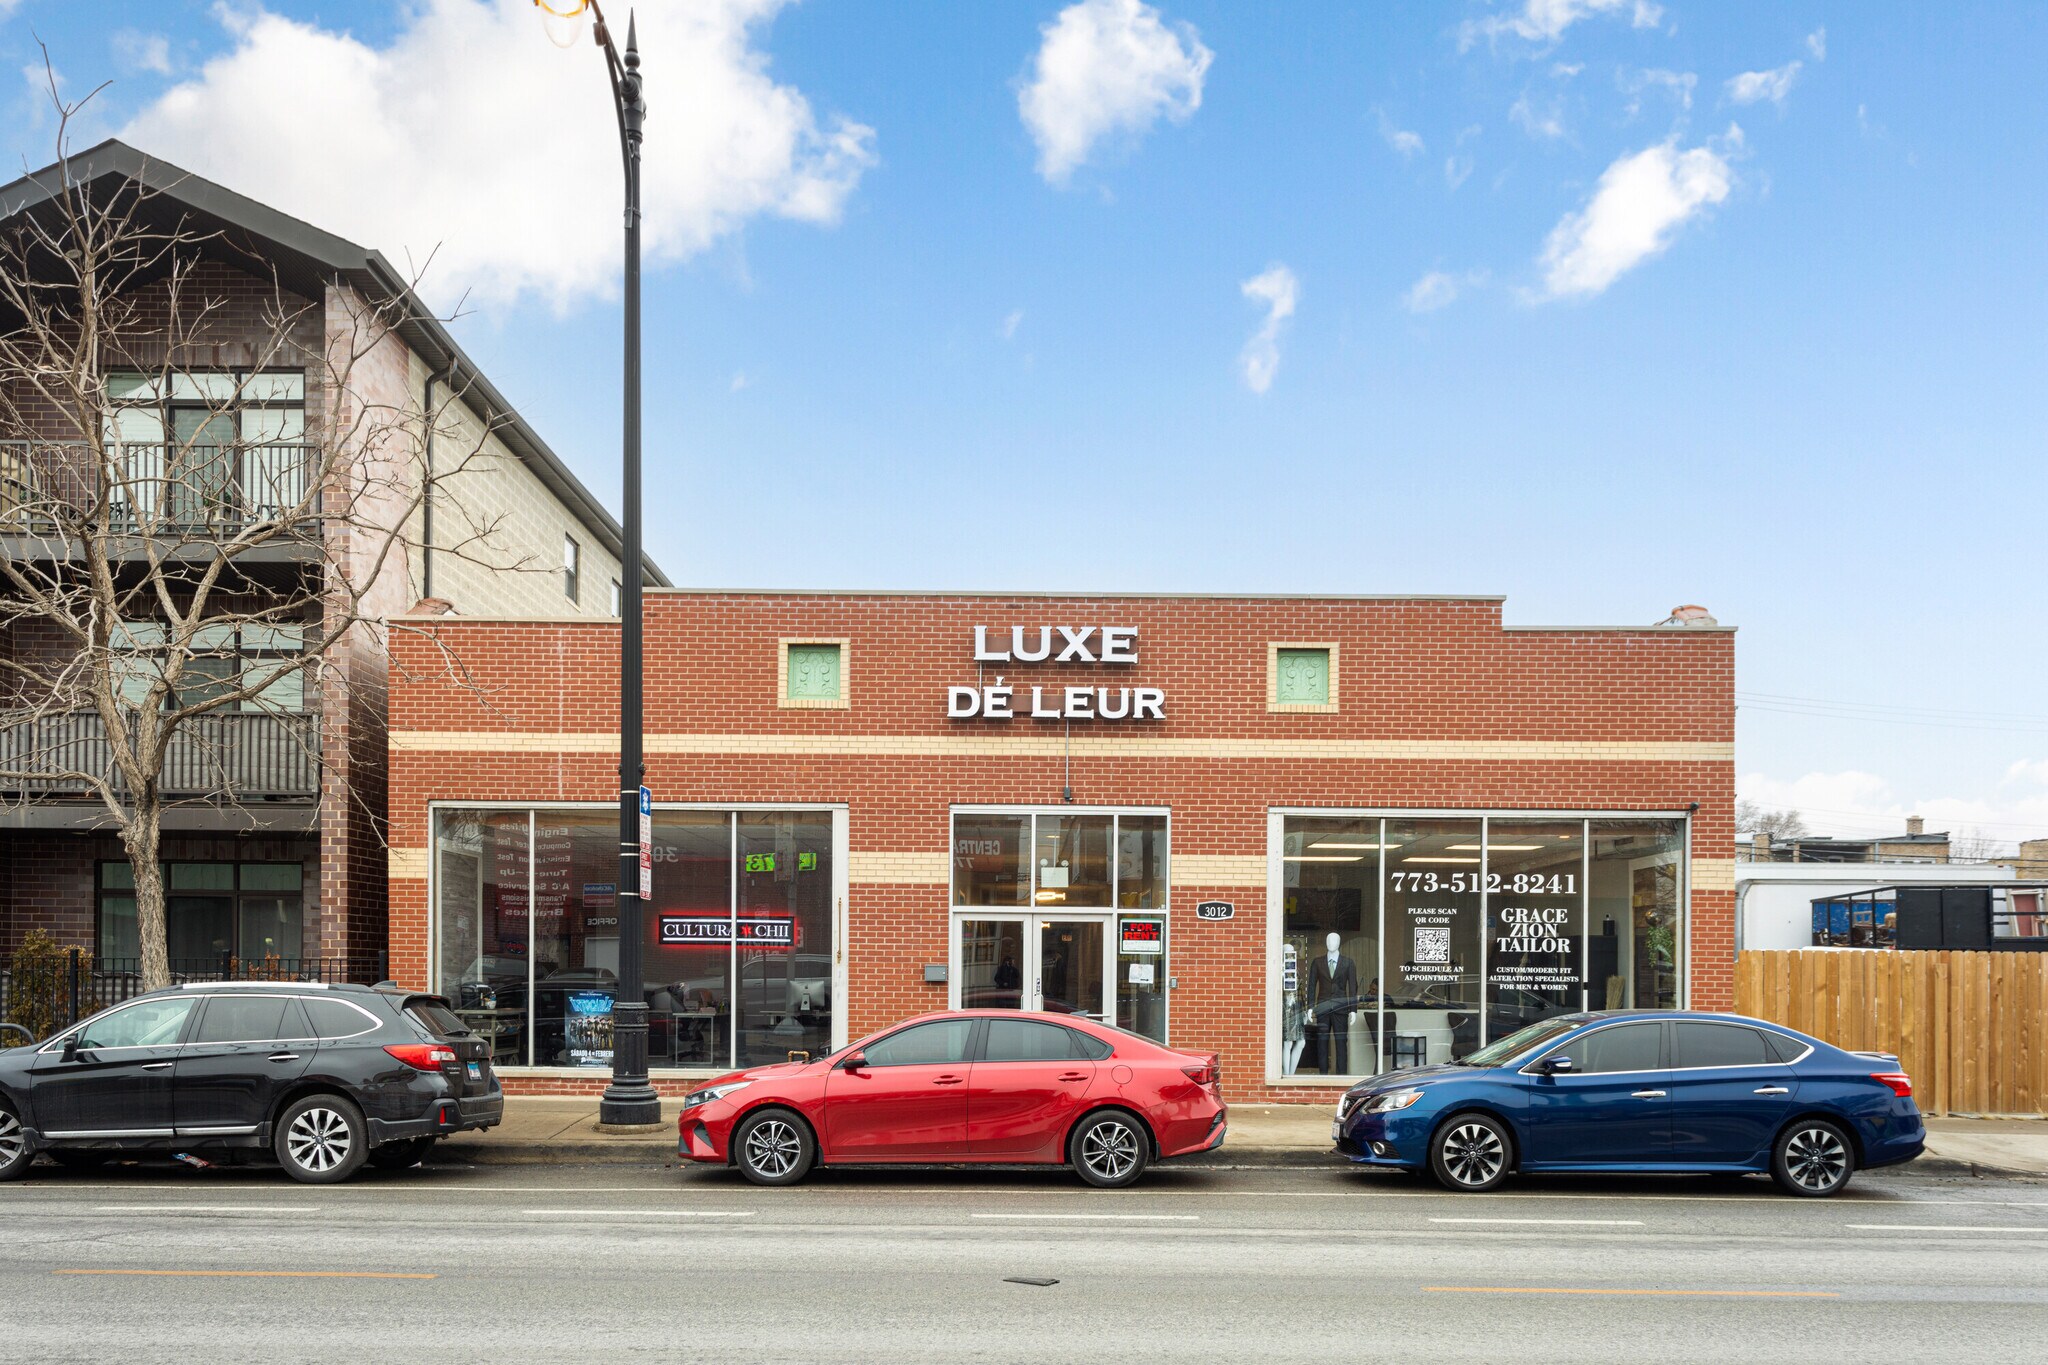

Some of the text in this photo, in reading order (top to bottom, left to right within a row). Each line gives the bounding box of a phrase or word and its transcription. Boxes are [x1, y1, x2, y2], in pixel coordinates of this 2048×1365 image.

[973, 625, 1138, 664] LUXE
[947, 676, 1166, 719] DÉ LEUR
[1390, 873, 1577, 894] 773-512-8241
[1204, 906, 1227, 917] 3012
[1407, 907, 1437, 915] PLEASE
[1500, 908, 1568, 924] GRACE
[1130, 923, 1153, 932] FOR
[1510, 923, 1559, 938] ZION
[1123, 932, 1159, 941] RENT
[1497, 938, 1571, 953] TAILOR
[1412, 965, 1452, 973] SCHEDULE
[1496, 966, 1558, 974] CUSTOM/MODERN
[1404, 974, 1460, 982] APPOINTMENT
[1534, 975, 1580, 983] SPECIALISTS
